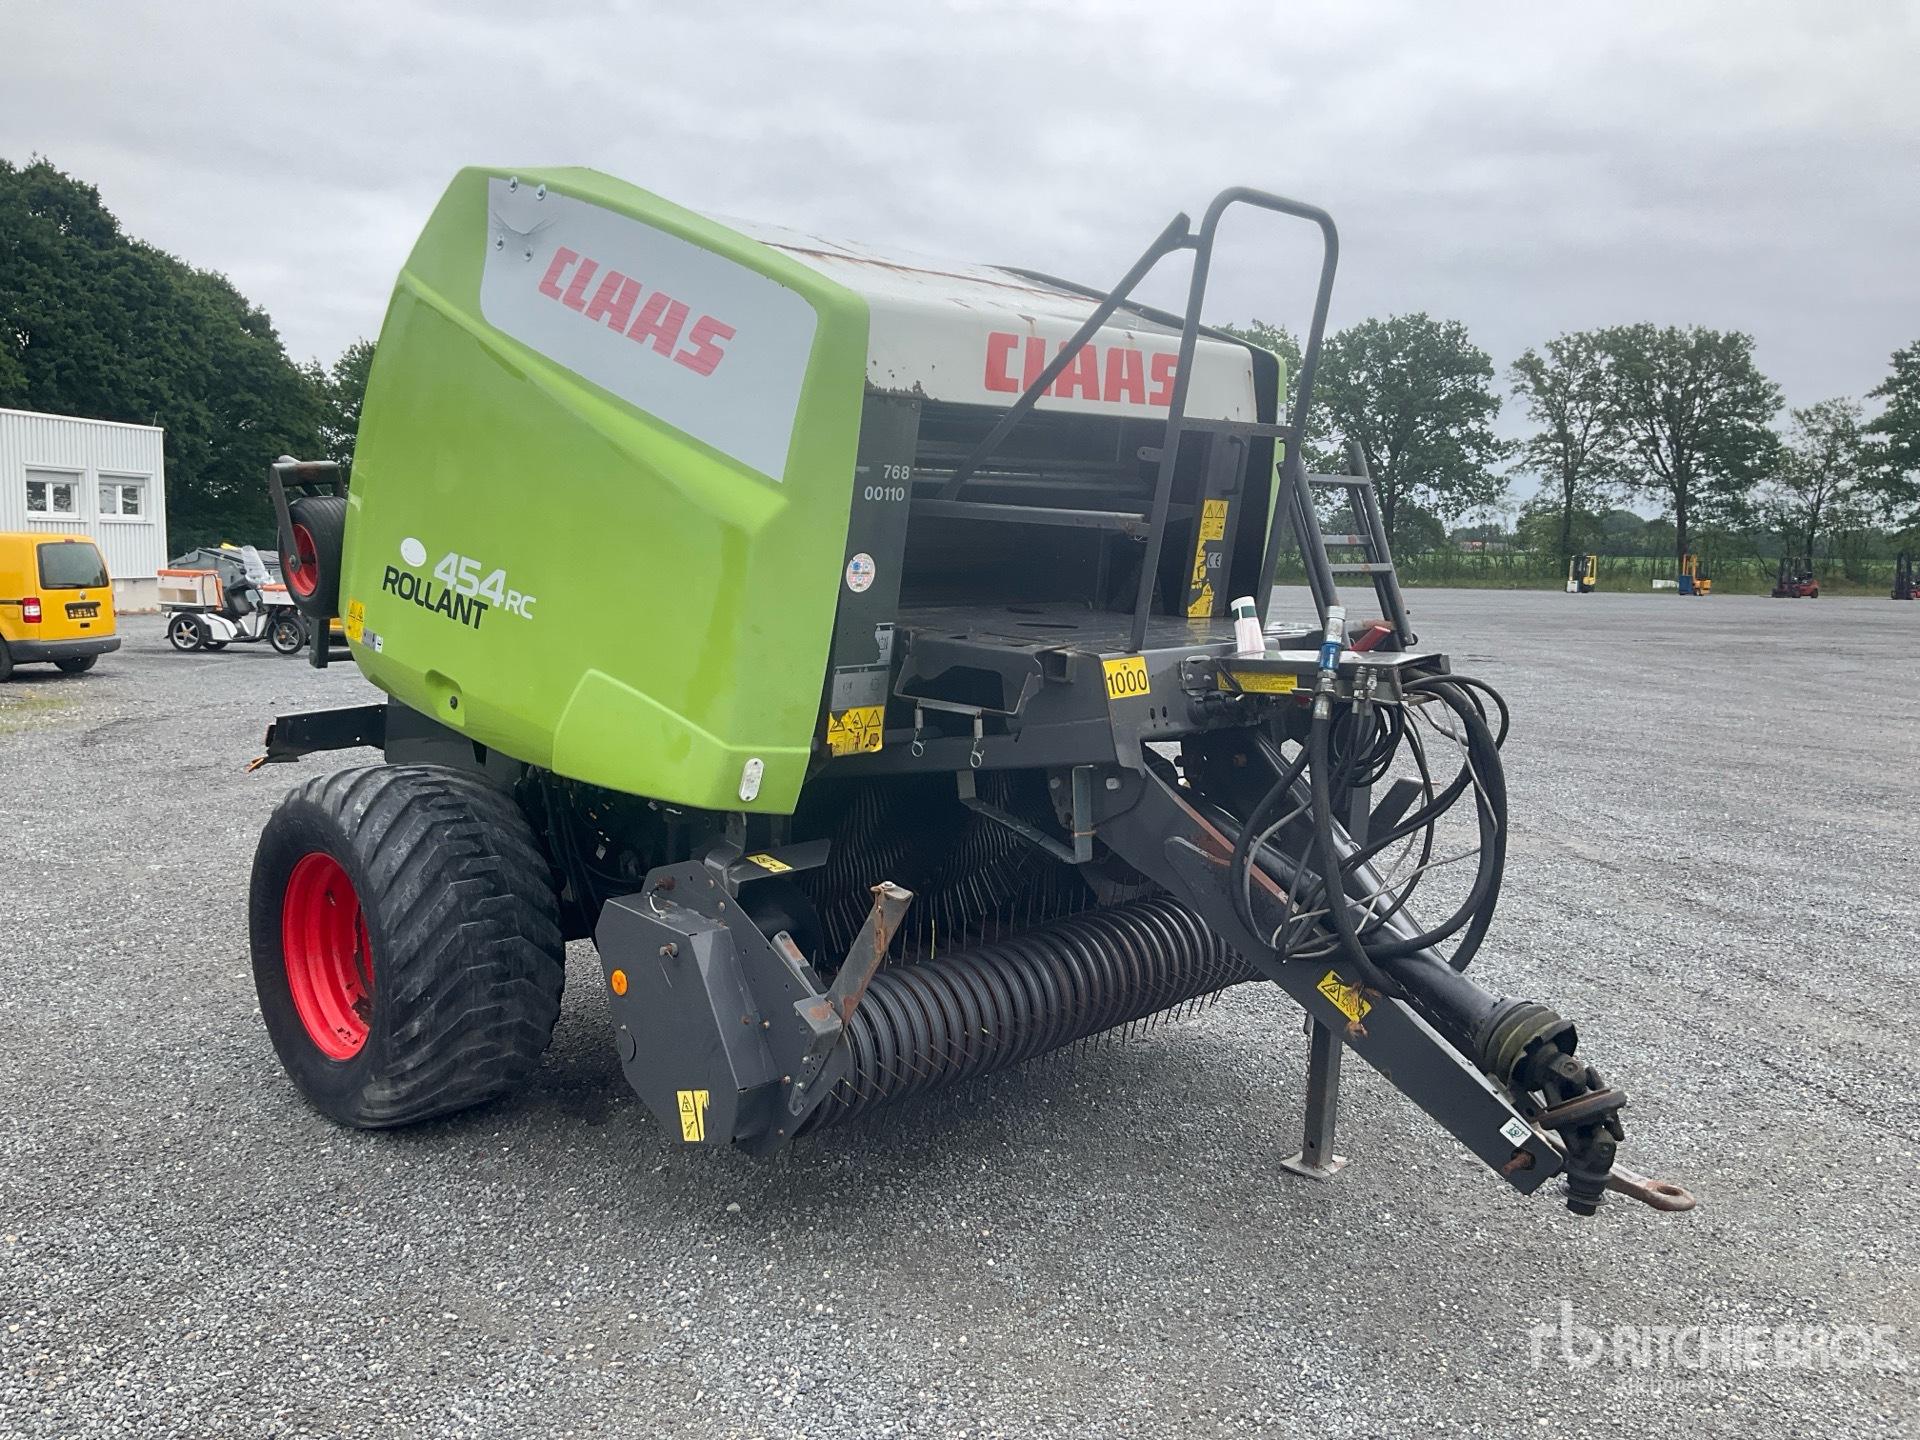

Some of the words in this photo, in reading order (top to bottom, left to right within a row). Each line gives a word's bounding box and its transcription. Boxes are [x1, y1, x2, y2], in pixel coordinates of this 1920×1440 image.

[538, 246, 737, 377] CLAAS
[984, 332, 1180, 407] CLAAS
[864, 485, 905, 502] 00110
[883, 464, 910, 480] 768
[382, 565, 489, 630] ROLLANT
[1107, 669, 1147, 695] 1000
